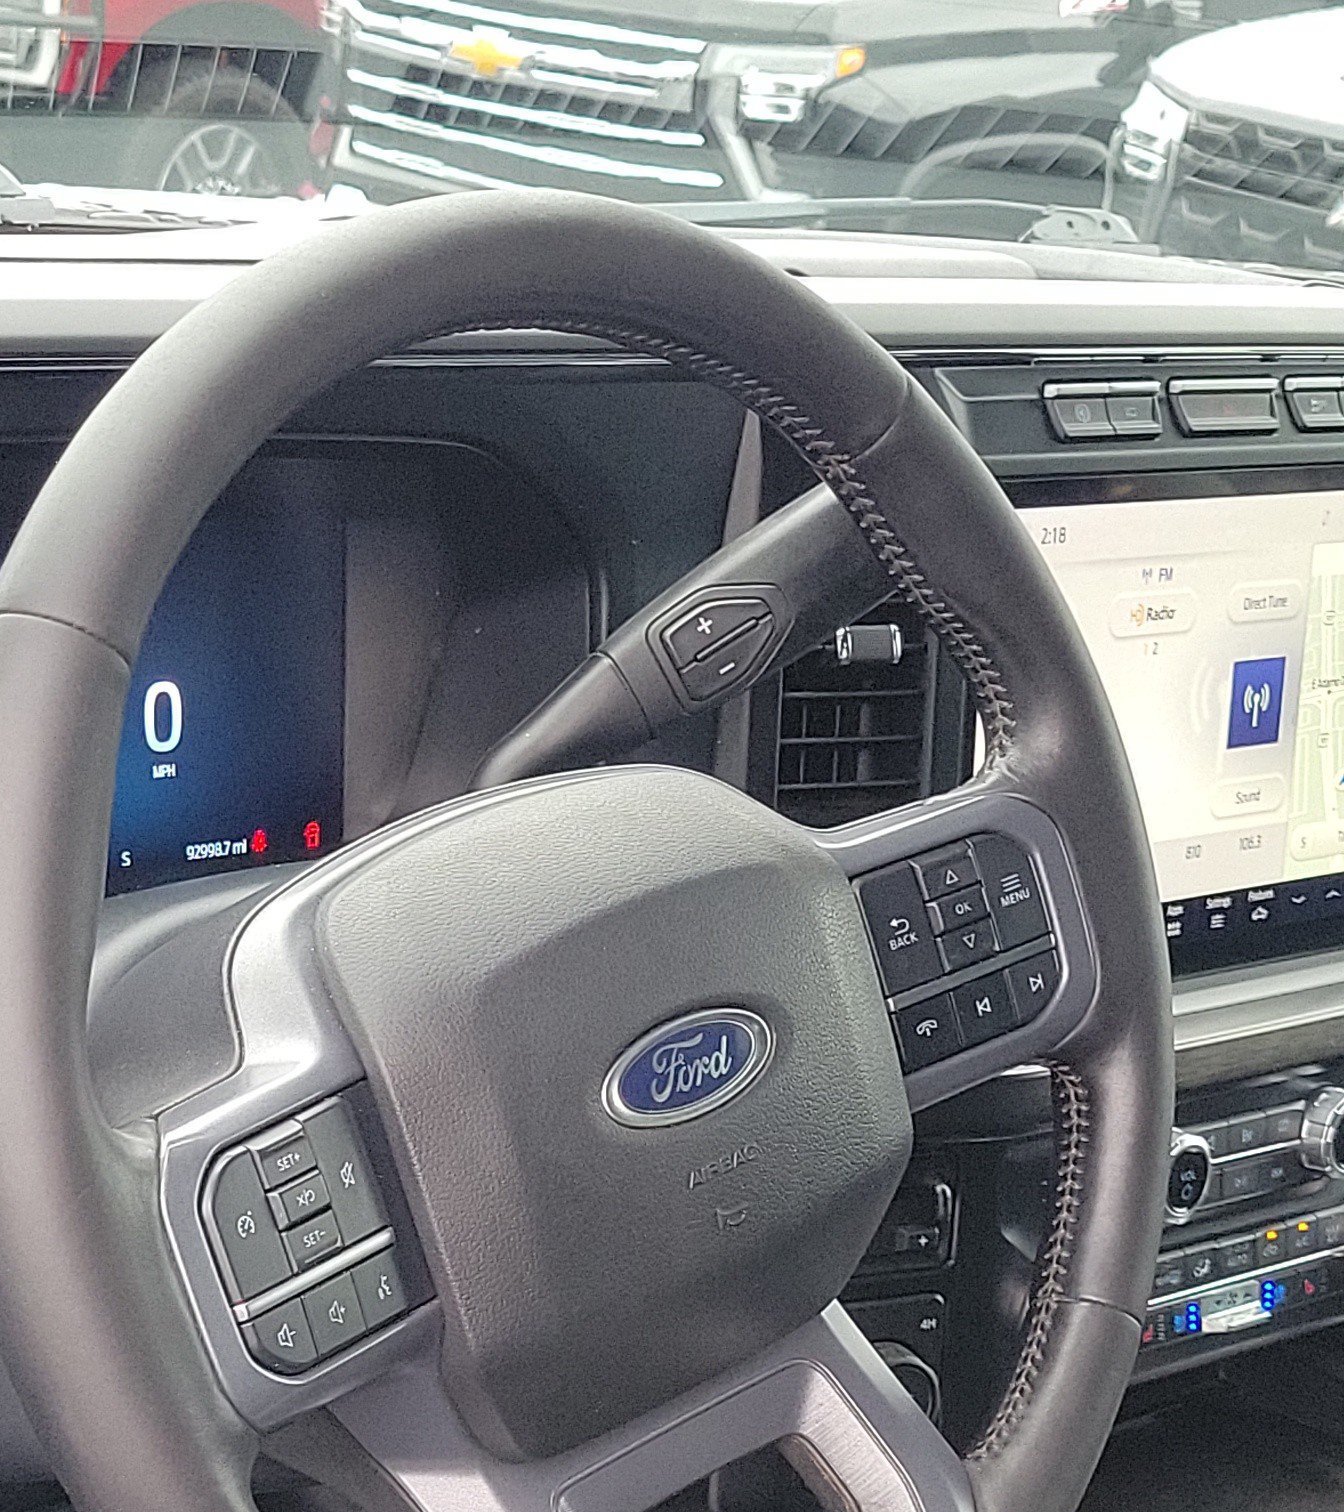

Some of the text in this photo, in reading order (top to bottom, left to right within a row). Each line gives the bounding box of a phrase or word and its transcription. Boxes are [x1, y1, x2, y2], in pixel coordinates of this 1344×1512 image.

[1040, 527, 1067, 545] 2:18
[143, 680, 183, 755] 0
[152, 763, 177, 779] MPH
[231, 838, 247, 855] mi
[1000, 886, 1031, 908] MENU
[954, 900, 974, 916] OK
[888, 932, 919, 952] BACK
[650, 1031, 733, 1104] Ford
[919, 1316, 937, 1331] 4H
